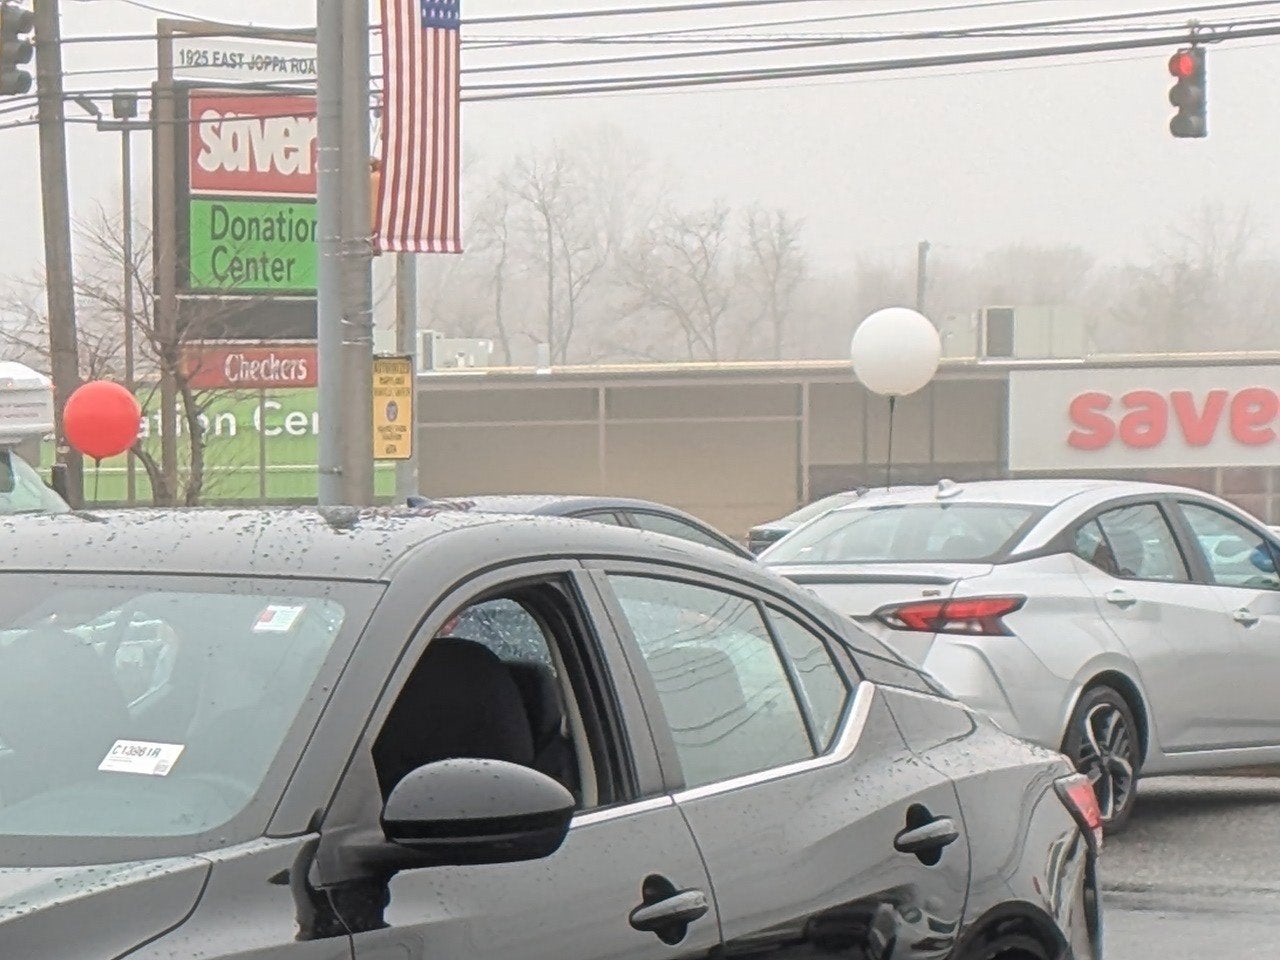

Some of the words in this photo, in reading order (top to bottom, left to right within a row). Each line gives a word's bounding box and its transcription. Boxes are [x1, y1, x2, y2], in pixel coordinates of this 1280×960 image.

[179, 49, 209, 66] 1925
[212, 51, 246, 69] EAST
[248, 55, 288, 73] JOPPA
[290, 57, 317, 74] ROA
[197, 110, 318, 176] saver
[211, 246, 296, 282] Center
[224, 353, 307, 382] Checkers
[1067, 388, 1280, 450] save
